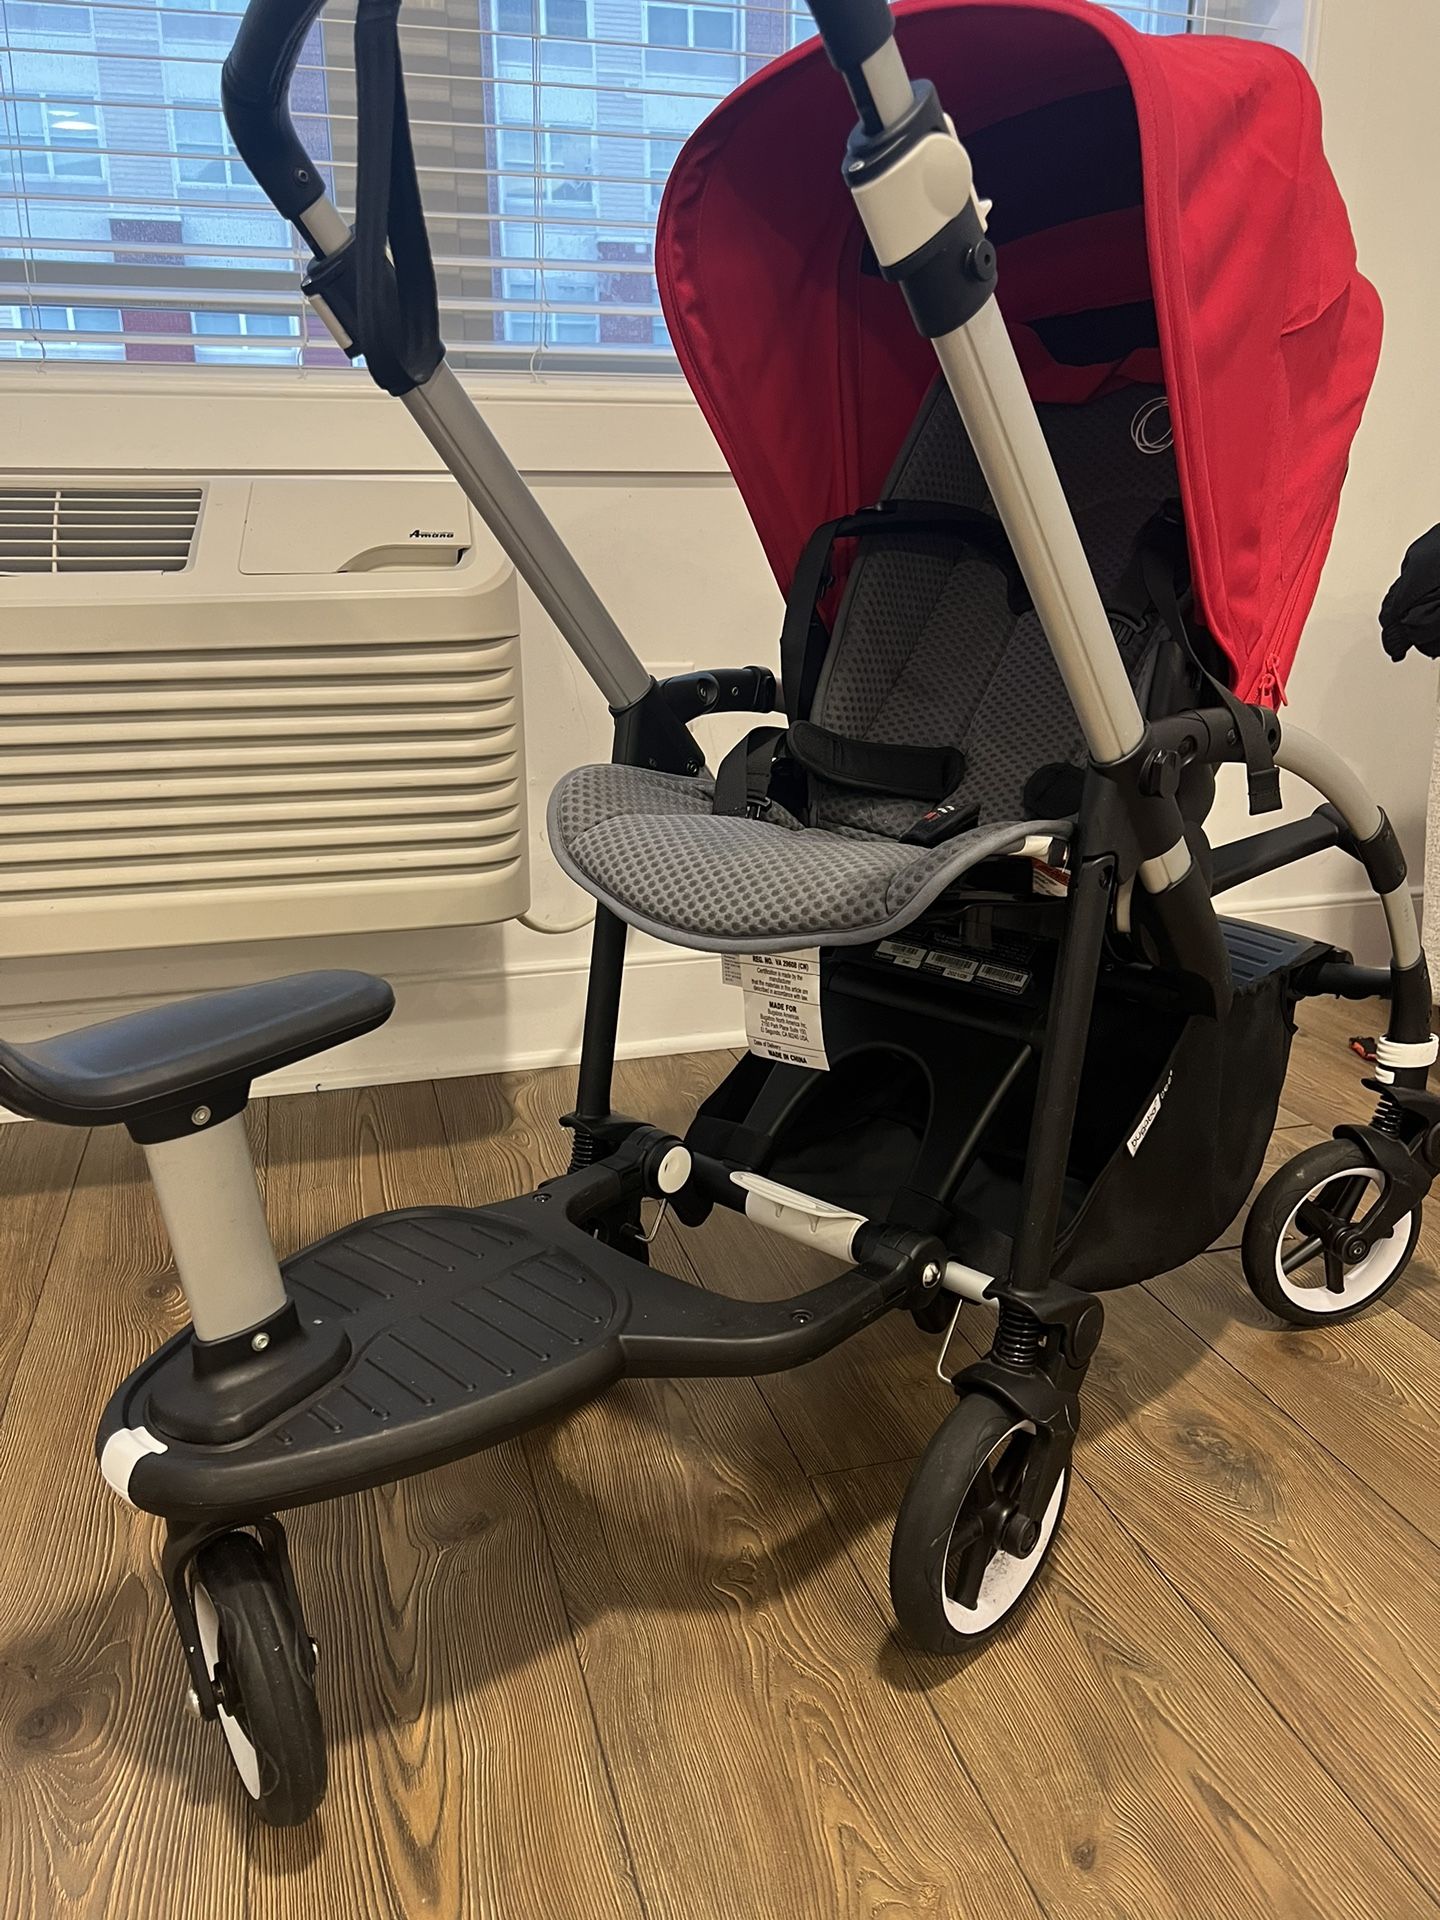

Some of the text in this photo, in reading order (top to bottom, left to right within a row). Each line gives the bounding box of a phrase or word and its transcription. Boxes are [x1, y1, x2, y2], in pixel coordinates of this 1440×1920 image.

[410, 530, 454, 538] Amana
[769, 1001, 797, 1013] MADE FOR
[768, 1050, 783, 1059] MADE
[790, 1055, 807, 1064] CHINA
